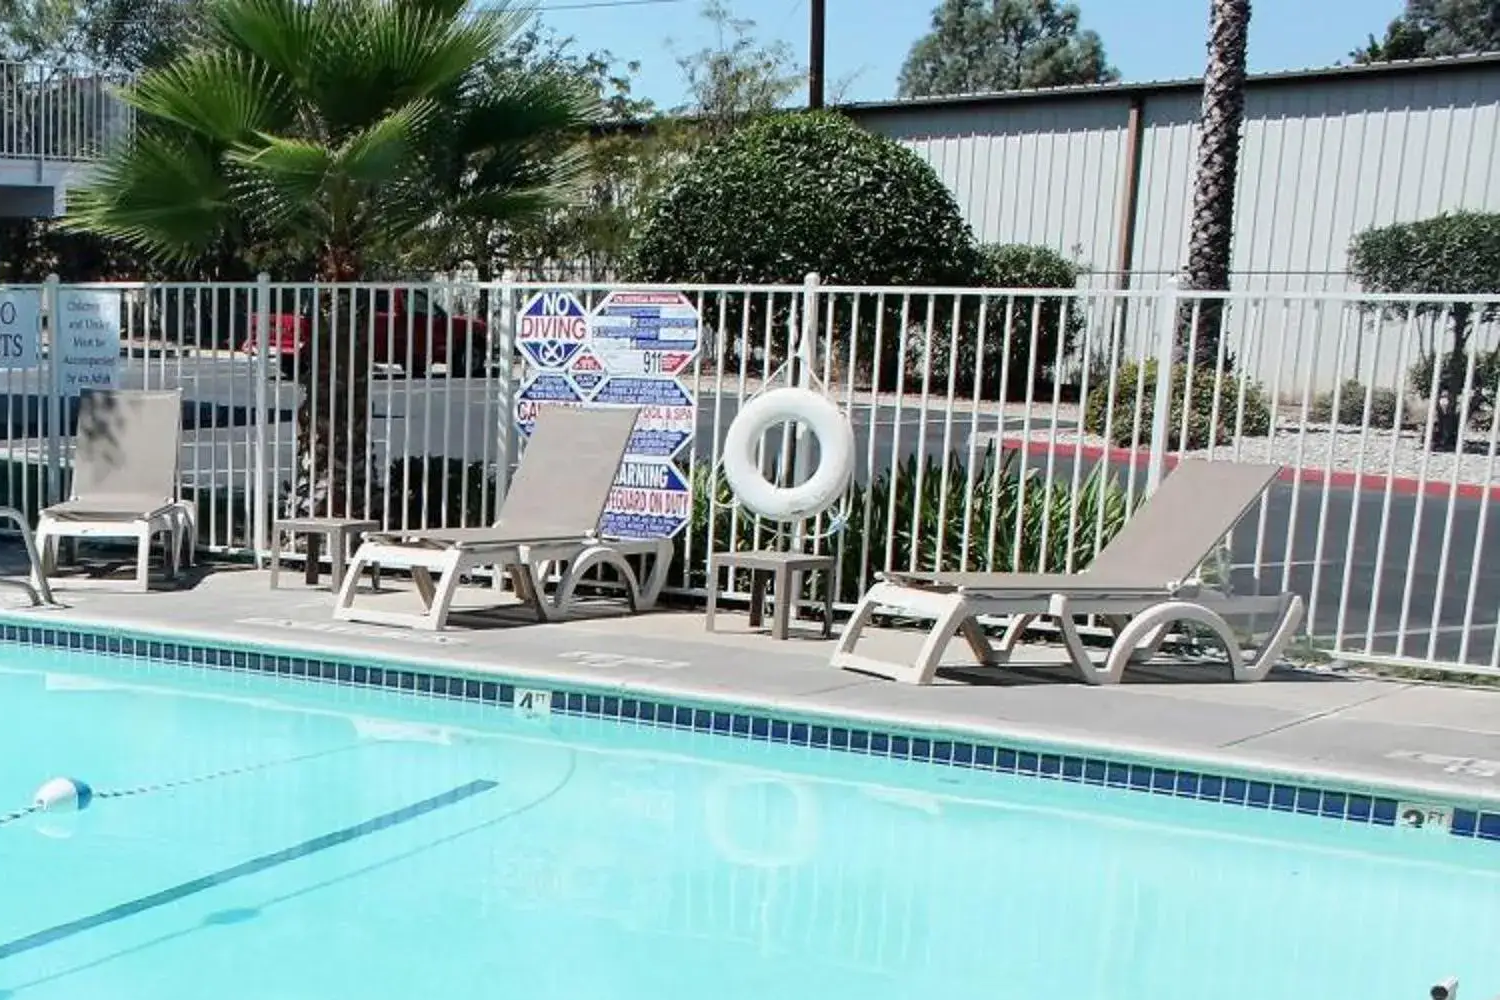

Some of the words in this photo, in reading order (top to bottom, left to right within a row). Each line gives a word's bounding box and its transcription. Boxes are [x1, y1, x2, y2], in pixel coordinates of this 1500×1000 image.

[543, 293, 570, 316] NO
[521, 317, 586, 340] DIVING
[643, 351, 661, 374] 911
